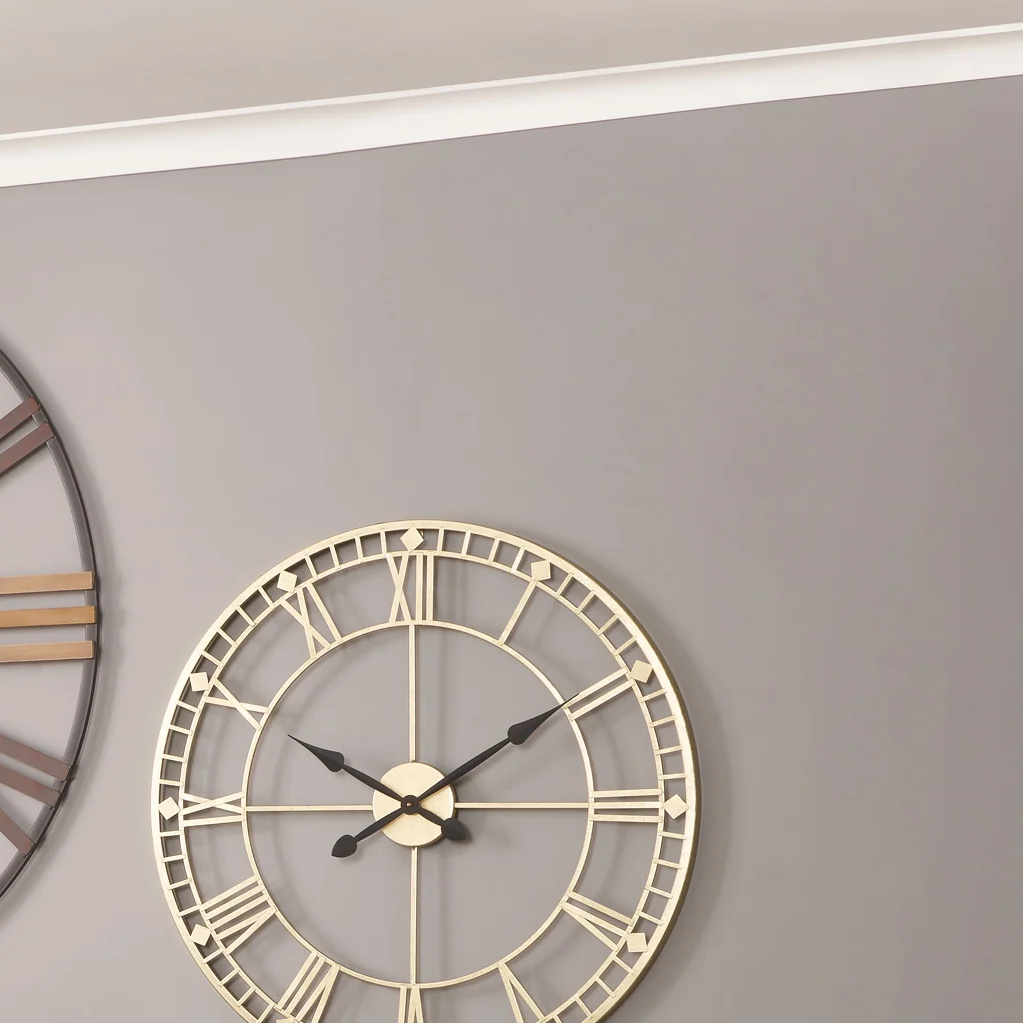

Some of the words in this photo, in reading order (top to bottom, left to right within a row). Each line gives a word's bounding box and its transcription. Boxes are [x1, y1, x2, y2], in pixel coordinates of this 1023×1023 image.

[387, 553, 435, 624] XII
[498, 581, 537, 645] I
[278, 581, 343, 659] XI
[203, 678, 270, 730] X
[179, 791, 246, 828] IX
[590, 788, 664, 824] III
